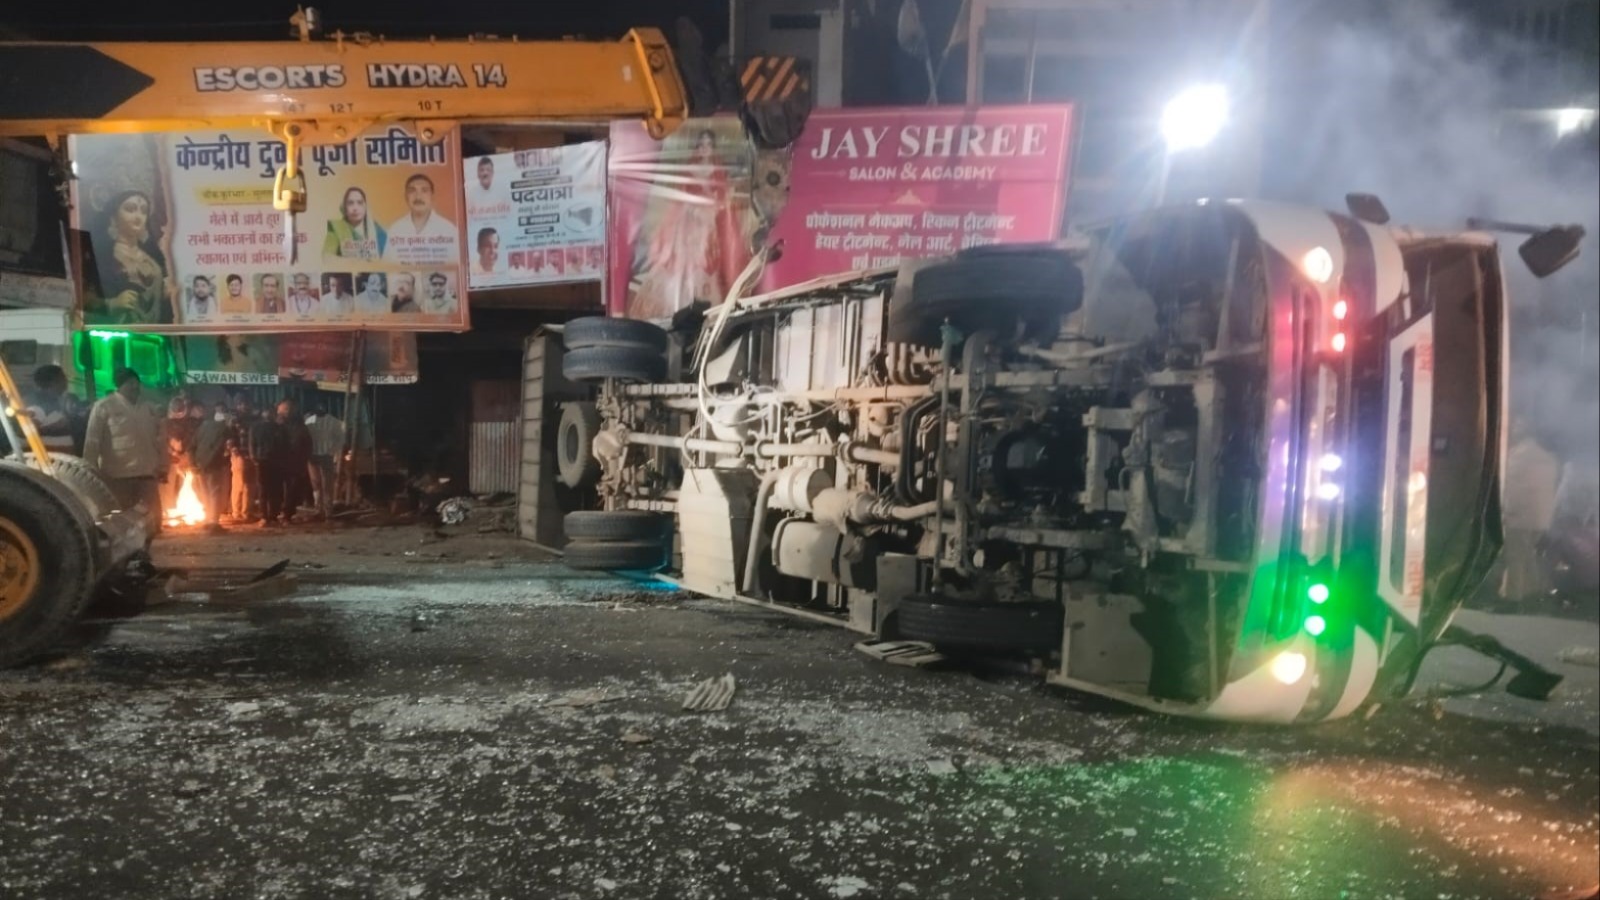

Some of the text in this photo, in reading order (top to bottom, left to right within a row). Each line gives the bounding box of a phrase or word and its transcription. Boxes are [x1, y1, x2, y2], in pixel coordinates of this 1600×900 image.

[193, 63, 506, 91] ESCORTS HYDRA 14
[330, 103, 354, 113] 12 T
[418, 101, 442, 111] 10 T
[811, 123, 1048, 160] JAY SHREE
[175, 134, 251, 171] केन्द्रीय
[848, 162, 996, 181] SALON & ACADEMY
[511, 186, 573, 204] पदयात्रा
[210, 211, 226, 226] मेले
[230, 210, 239, 226] में
[188, 231, 210, 246] सभी
[260, 232, 273, 245] का
[196, 253, 230, 266] स्वागत
